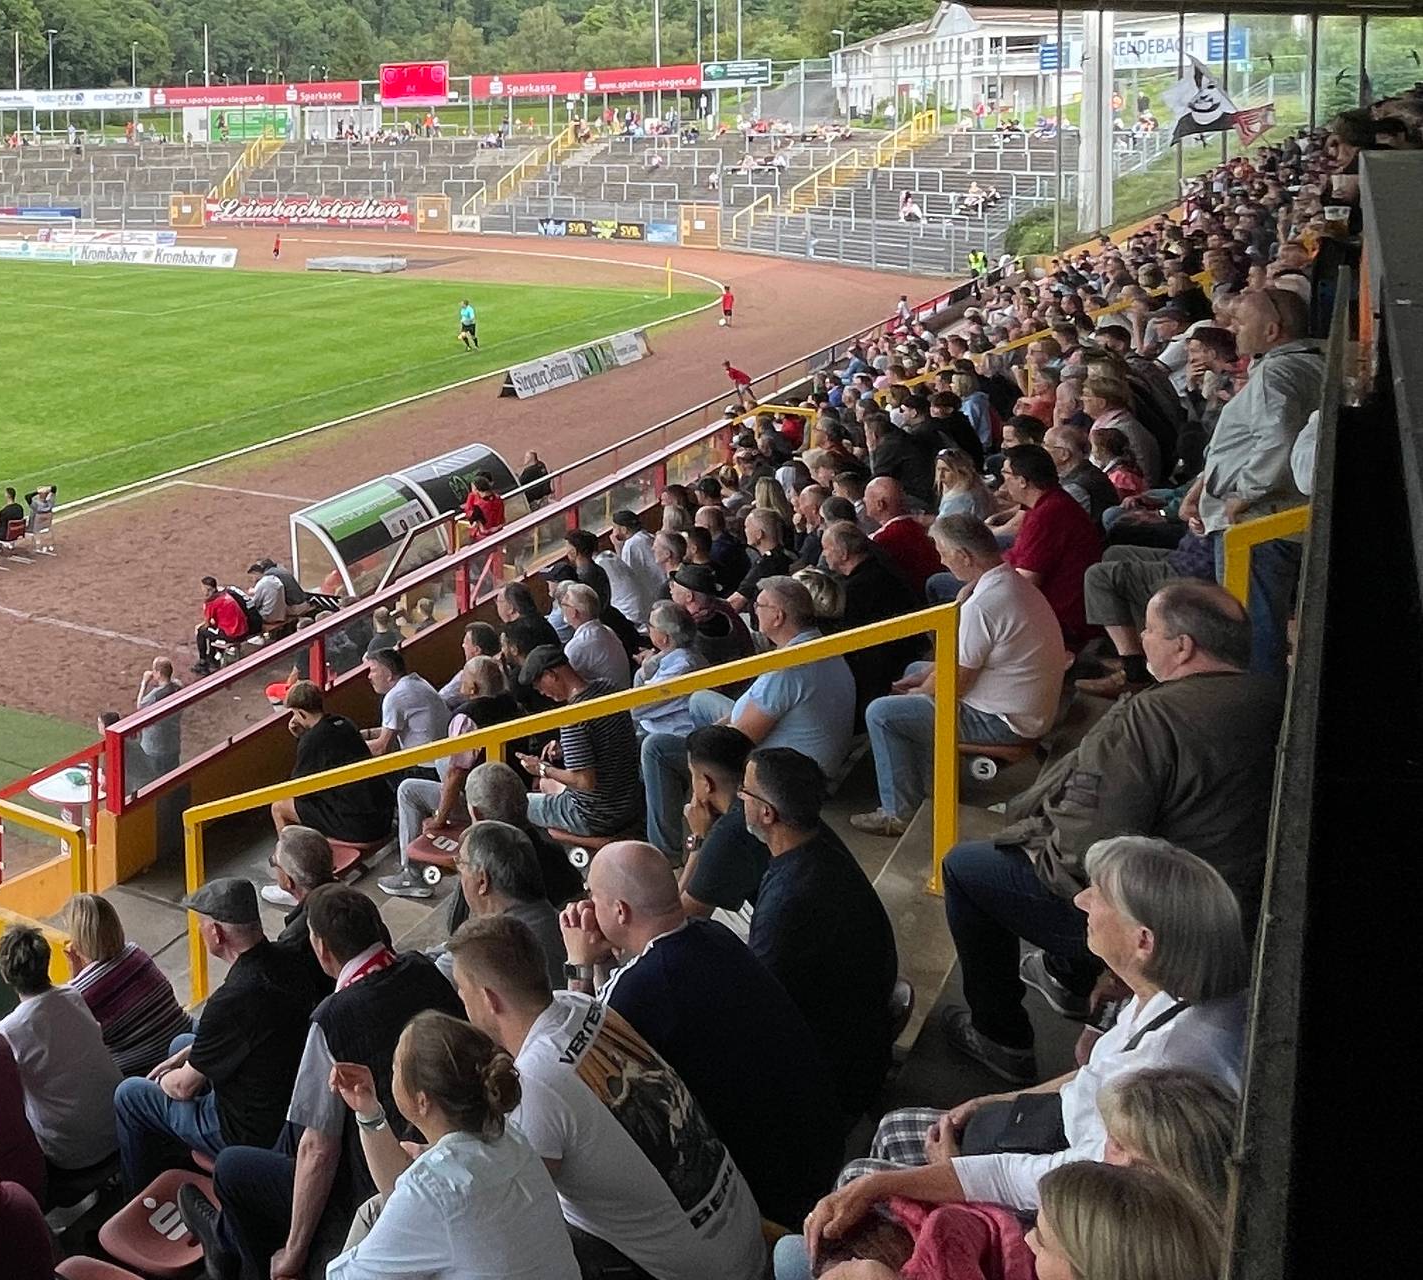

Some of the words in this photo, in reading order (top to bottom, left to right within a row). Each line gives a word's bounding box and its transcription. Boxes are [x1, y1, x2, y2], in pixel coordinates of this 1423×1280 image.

[1112, 37, 1194, 56] RENDEBACH
[506, 84, 556, 95] Sparkasse
[599, 76, 697, 91] www.sparkasse-siegen.de
[299, 92, 342, 101] Sparkasse
[215, 198, 401, 218] Leimbachstadion
[81, 245, 137, 262] Krombacher
[155, 248, 216, 265] Krombacher
[978, 763, 989, 774] 5
[574, 851, 583, 863] 3
